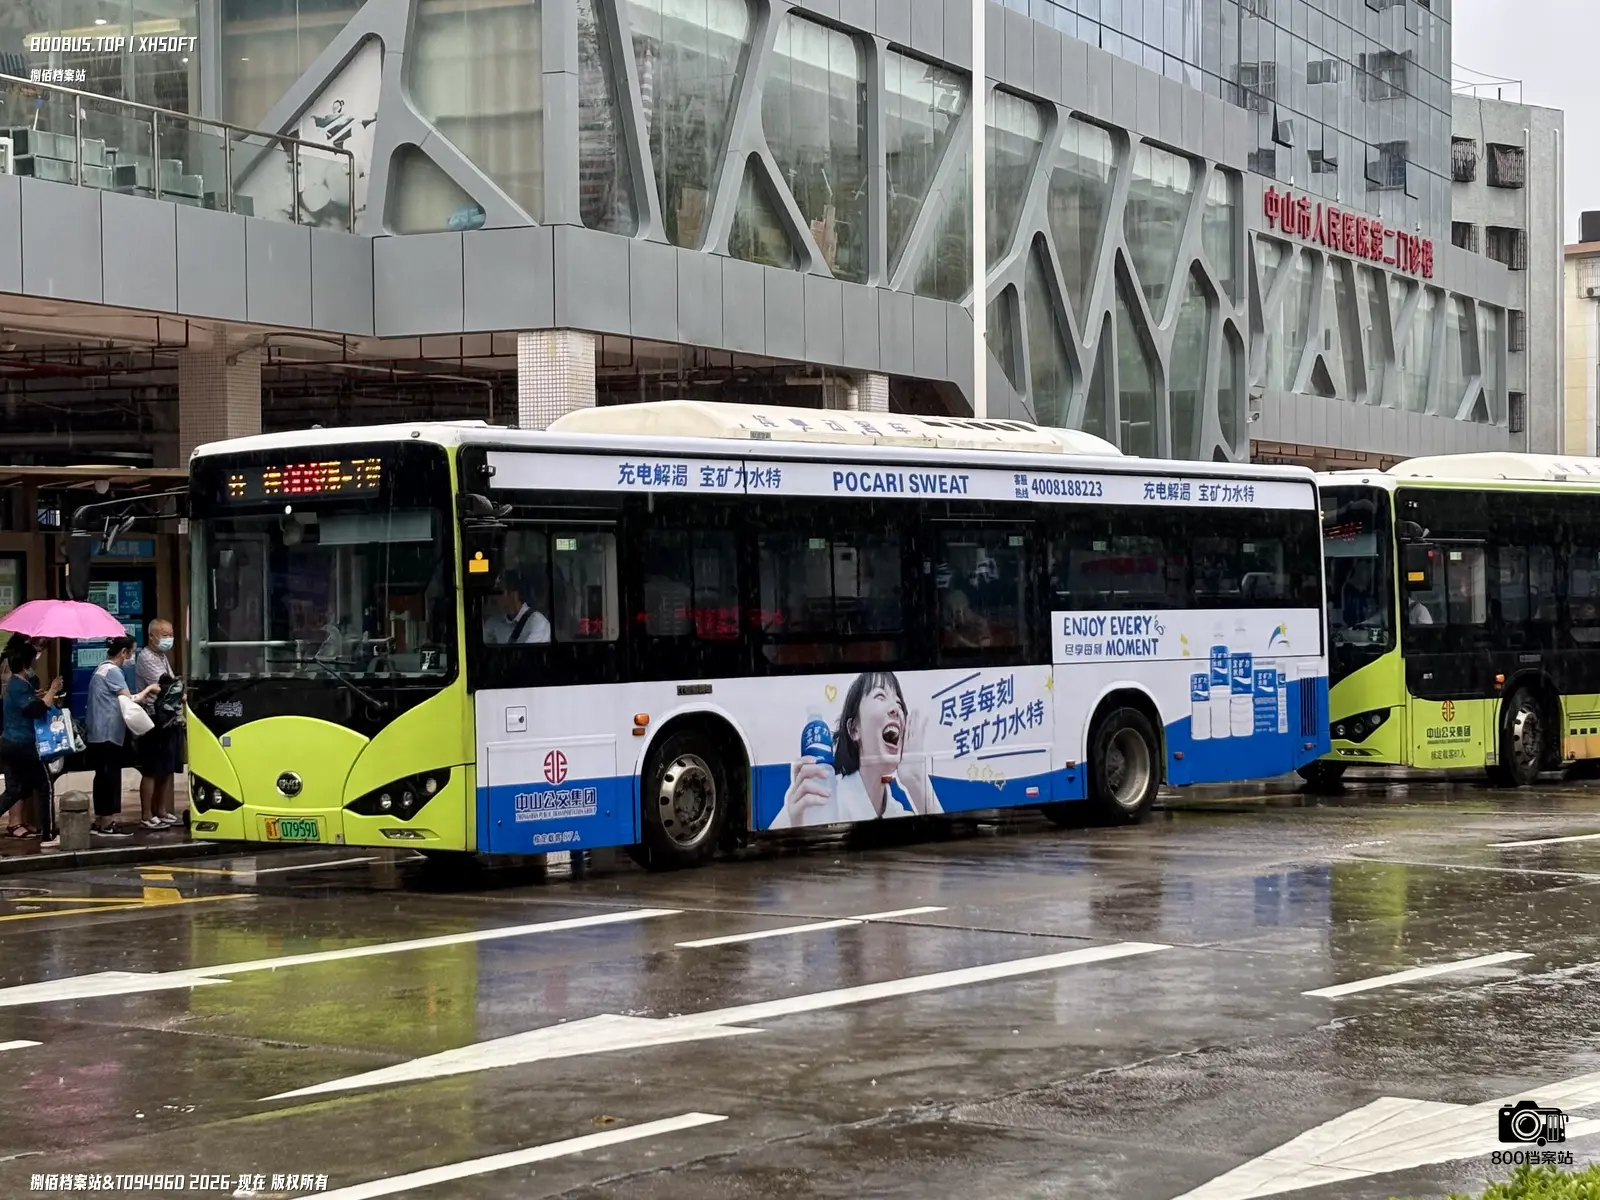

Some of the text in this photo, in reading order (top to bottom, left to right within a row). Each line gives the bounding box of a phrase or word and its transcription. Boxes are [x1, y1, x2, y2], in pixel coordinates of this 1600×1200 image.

[617, 463, 782, 489] 充电解渴 宝矿力水特
[832, 471, 969, 494] POCARI SWEAT
[1031, 478, 1103, 497] 4008188223
[1143, 481, 1255, 503] 充电解渴 宝矿力水特
[1063, 615, 1152, 637] ENJOY EVERY
[1106, 638, 1159, 656] MOMENT
[939, 674, 1014, 727] 尽享每刻
[953, 699, 1044, 759] 宝矿力水特
[1427, 725, 1471, 738] 中山公交集团
[515, 787, 597, 811] 中山公交集团
